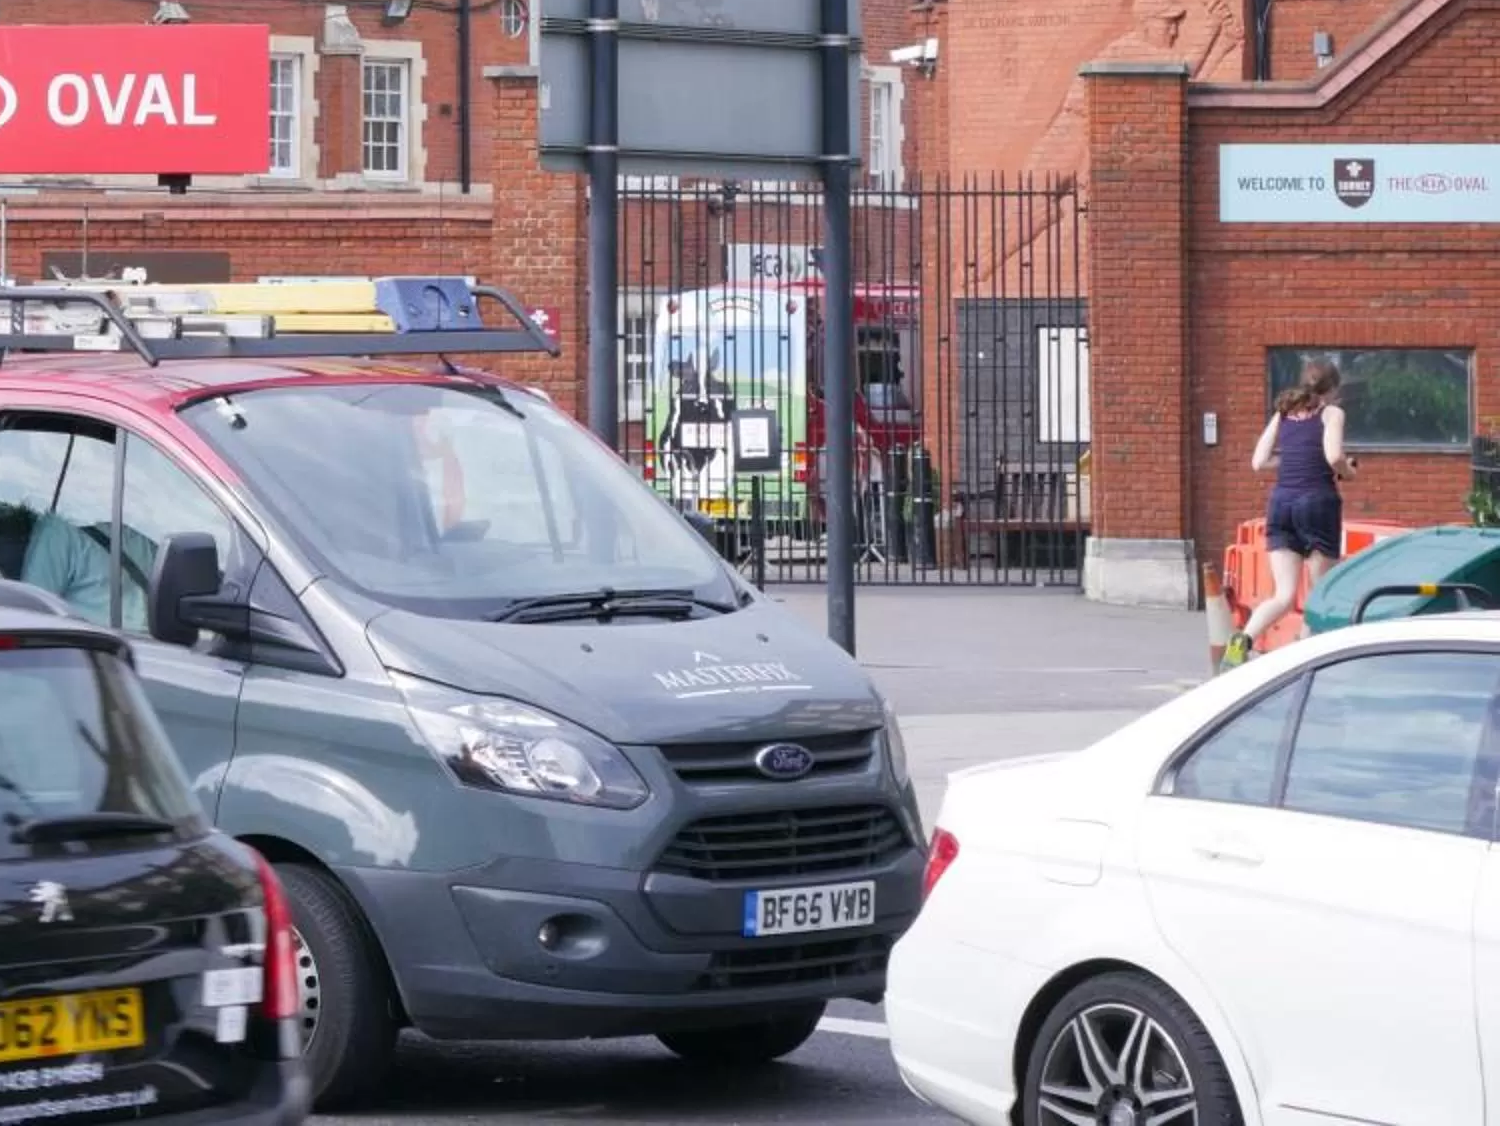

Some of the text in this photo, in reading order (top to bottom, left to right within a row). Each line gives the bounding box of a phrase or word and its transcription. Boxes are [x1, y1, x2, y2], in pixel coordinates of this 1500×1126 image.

[47, 73, 217, 126] OVAL
[1237, 176, 1325, 192] WELCOME TO
[1387, 176, 1412, 191] THE
[1452, 176, 1489, 191] OVAL
[773, 750, 804, 770] Ford
[763, 892, 822, 928] BF65
